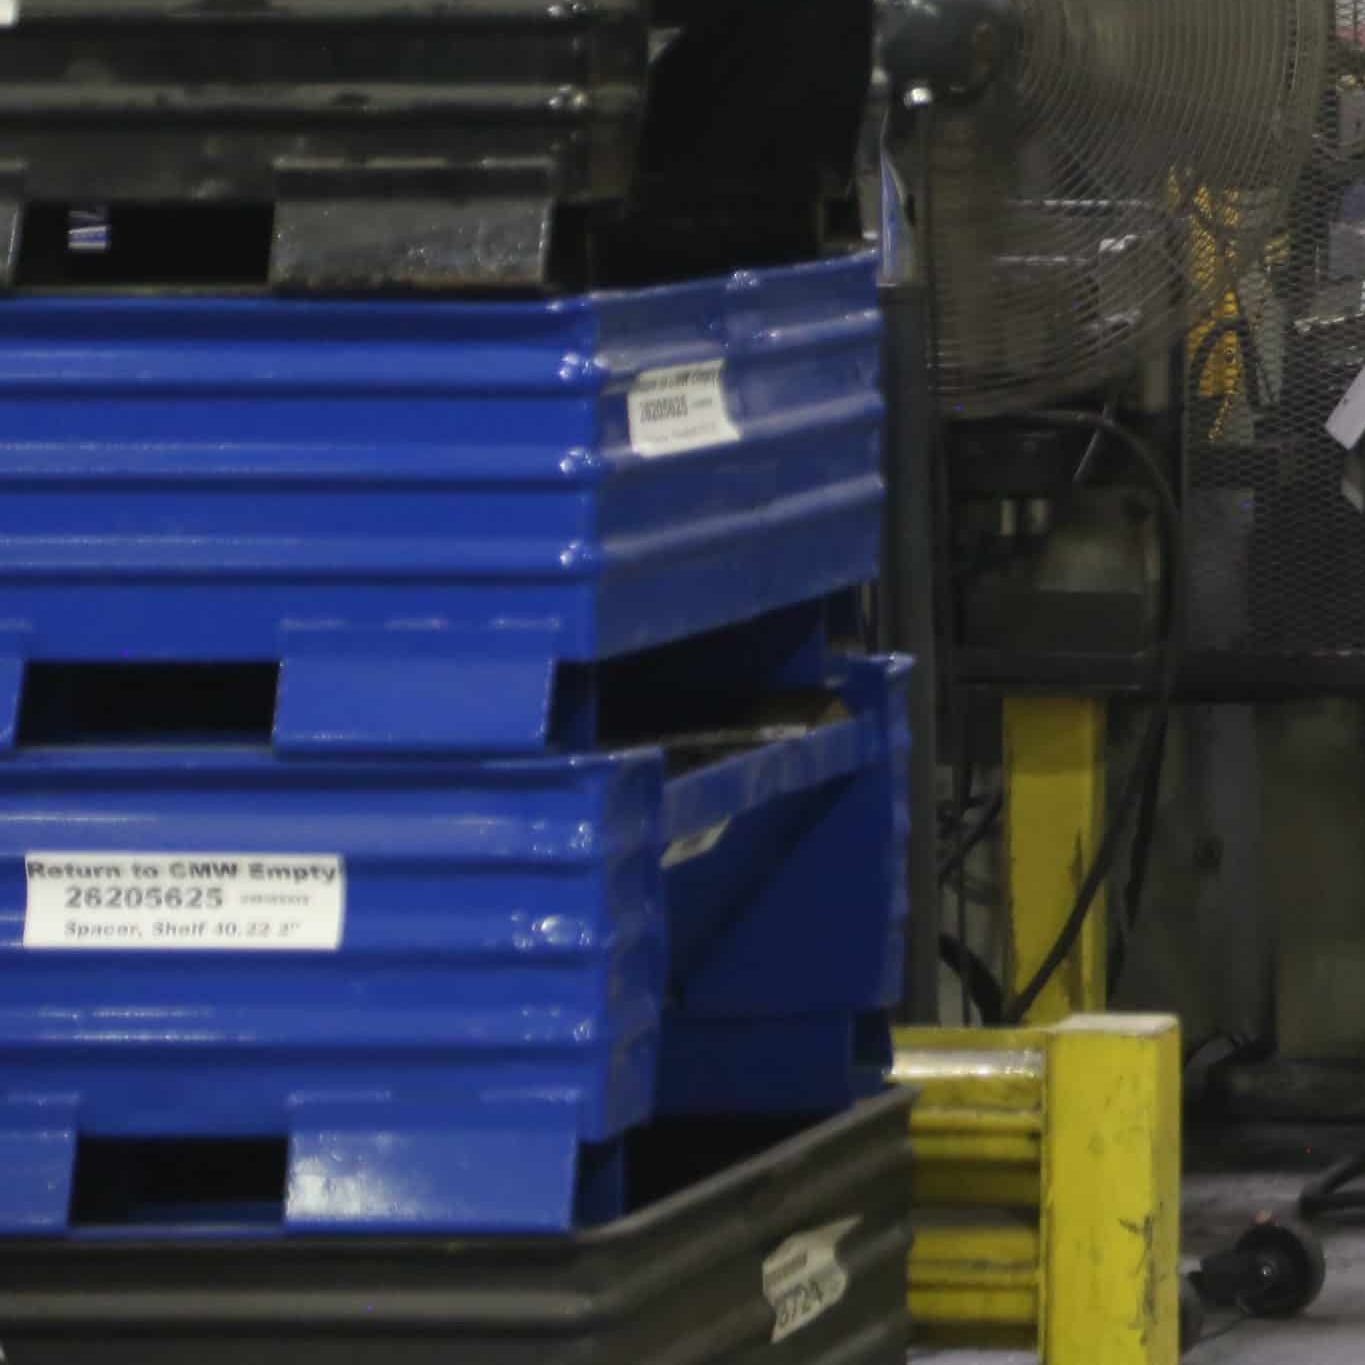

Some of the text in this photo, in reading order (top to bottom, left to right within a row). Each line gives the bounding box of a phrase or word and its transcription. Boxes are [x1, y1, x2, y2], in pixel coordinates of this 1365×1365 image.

[27, 861, 122, 880] Return
[131, 862, 159, 880] to
[249, 862, 337, 884] Empty
[65, 886, 224, 909] 26205625
